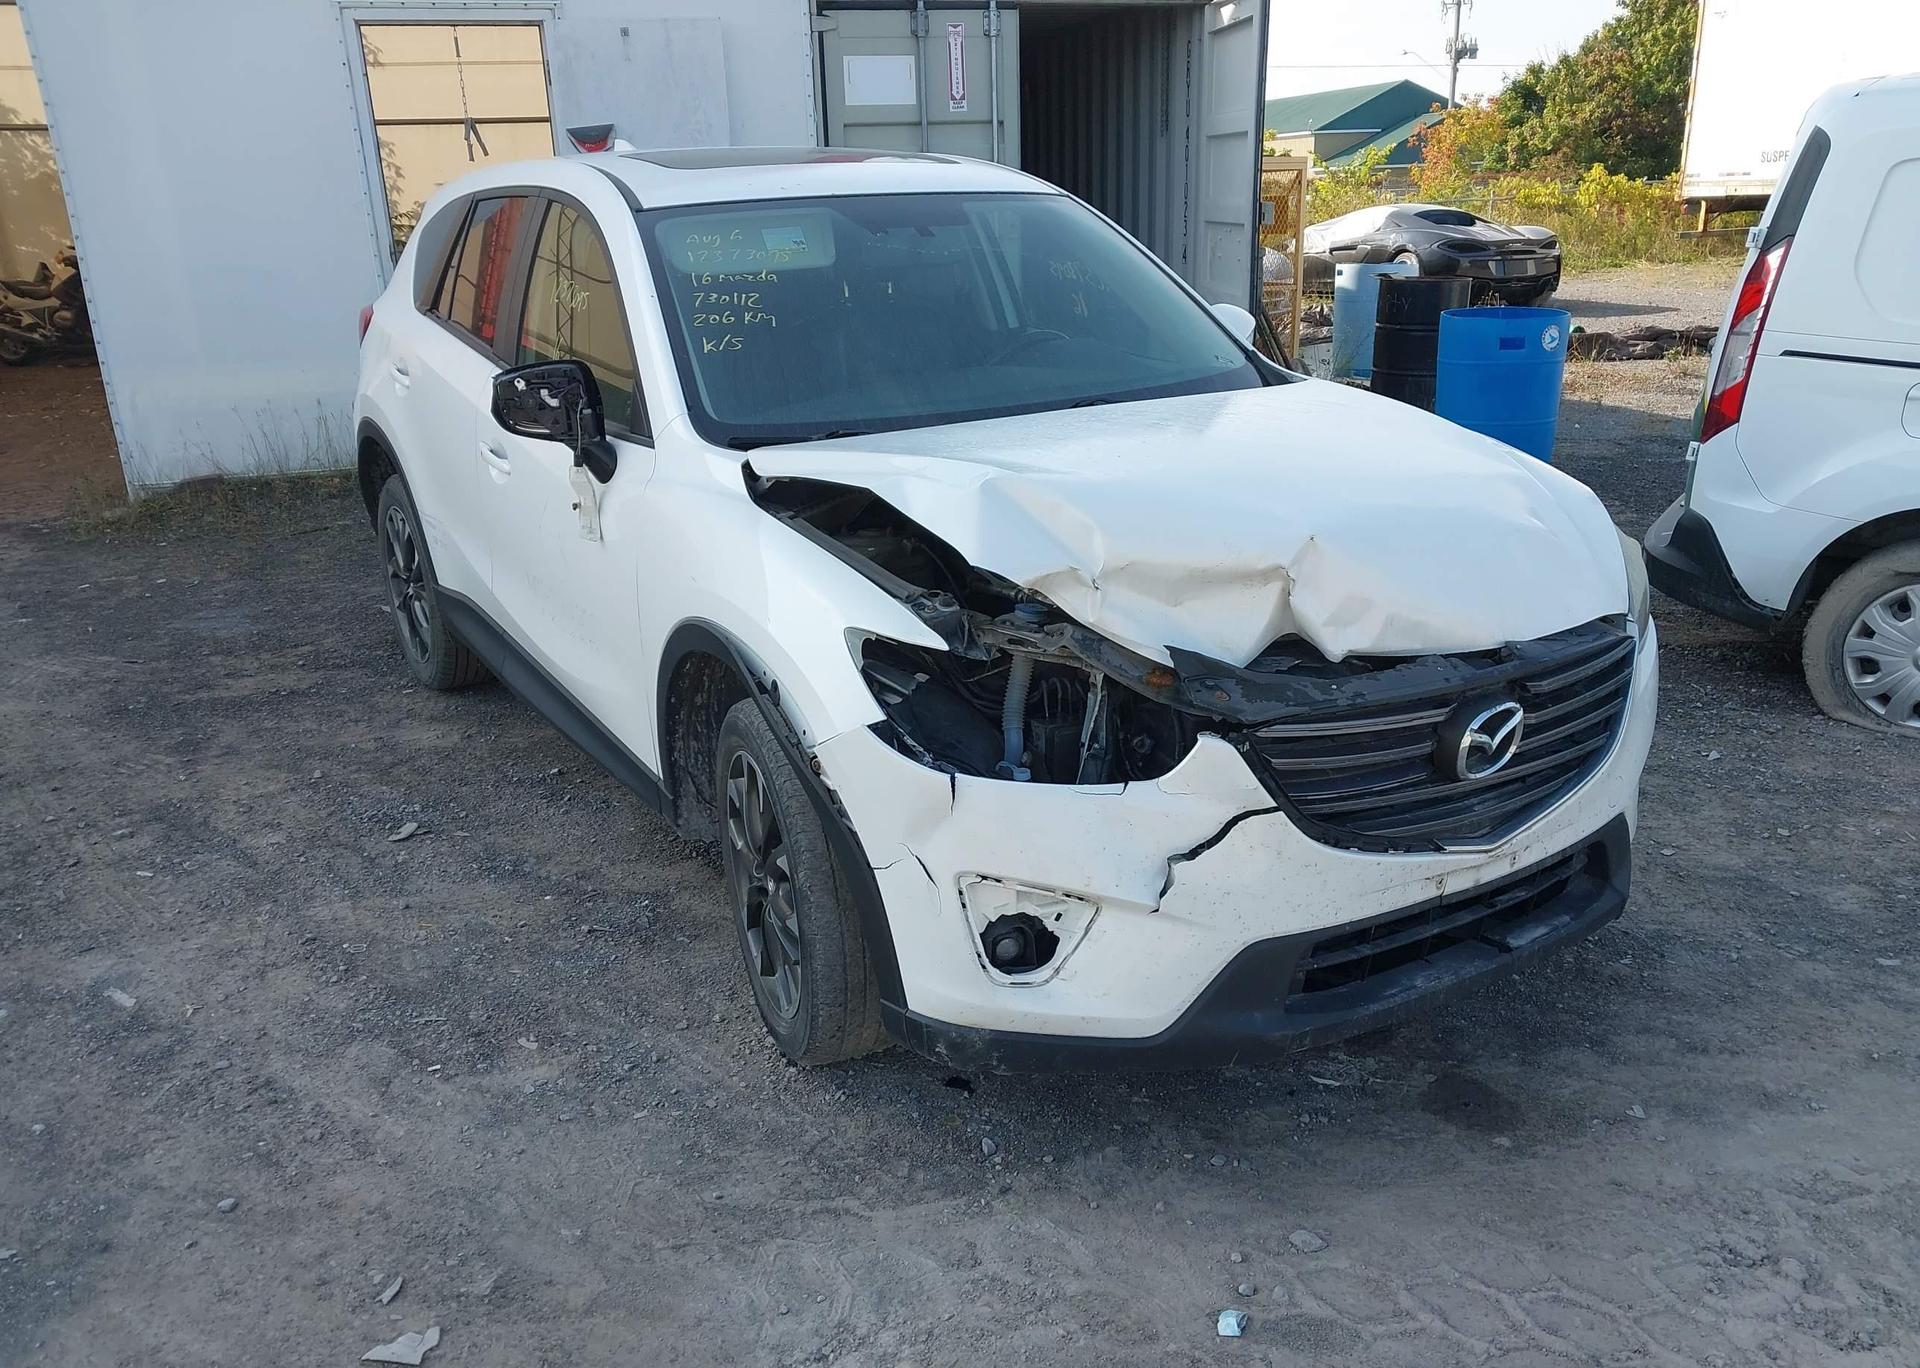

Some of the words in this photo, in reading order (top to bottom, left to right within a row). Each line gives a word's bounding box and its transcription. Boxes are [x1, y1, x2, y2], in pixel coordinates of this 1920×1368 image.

[686, 234, 720, 248] Aug
[730, 229, 743, 240] 6
[691, 272, 712, 287] 16
[692, 292, 763, 308] 730112
[693, 311, 735, 327] 206
